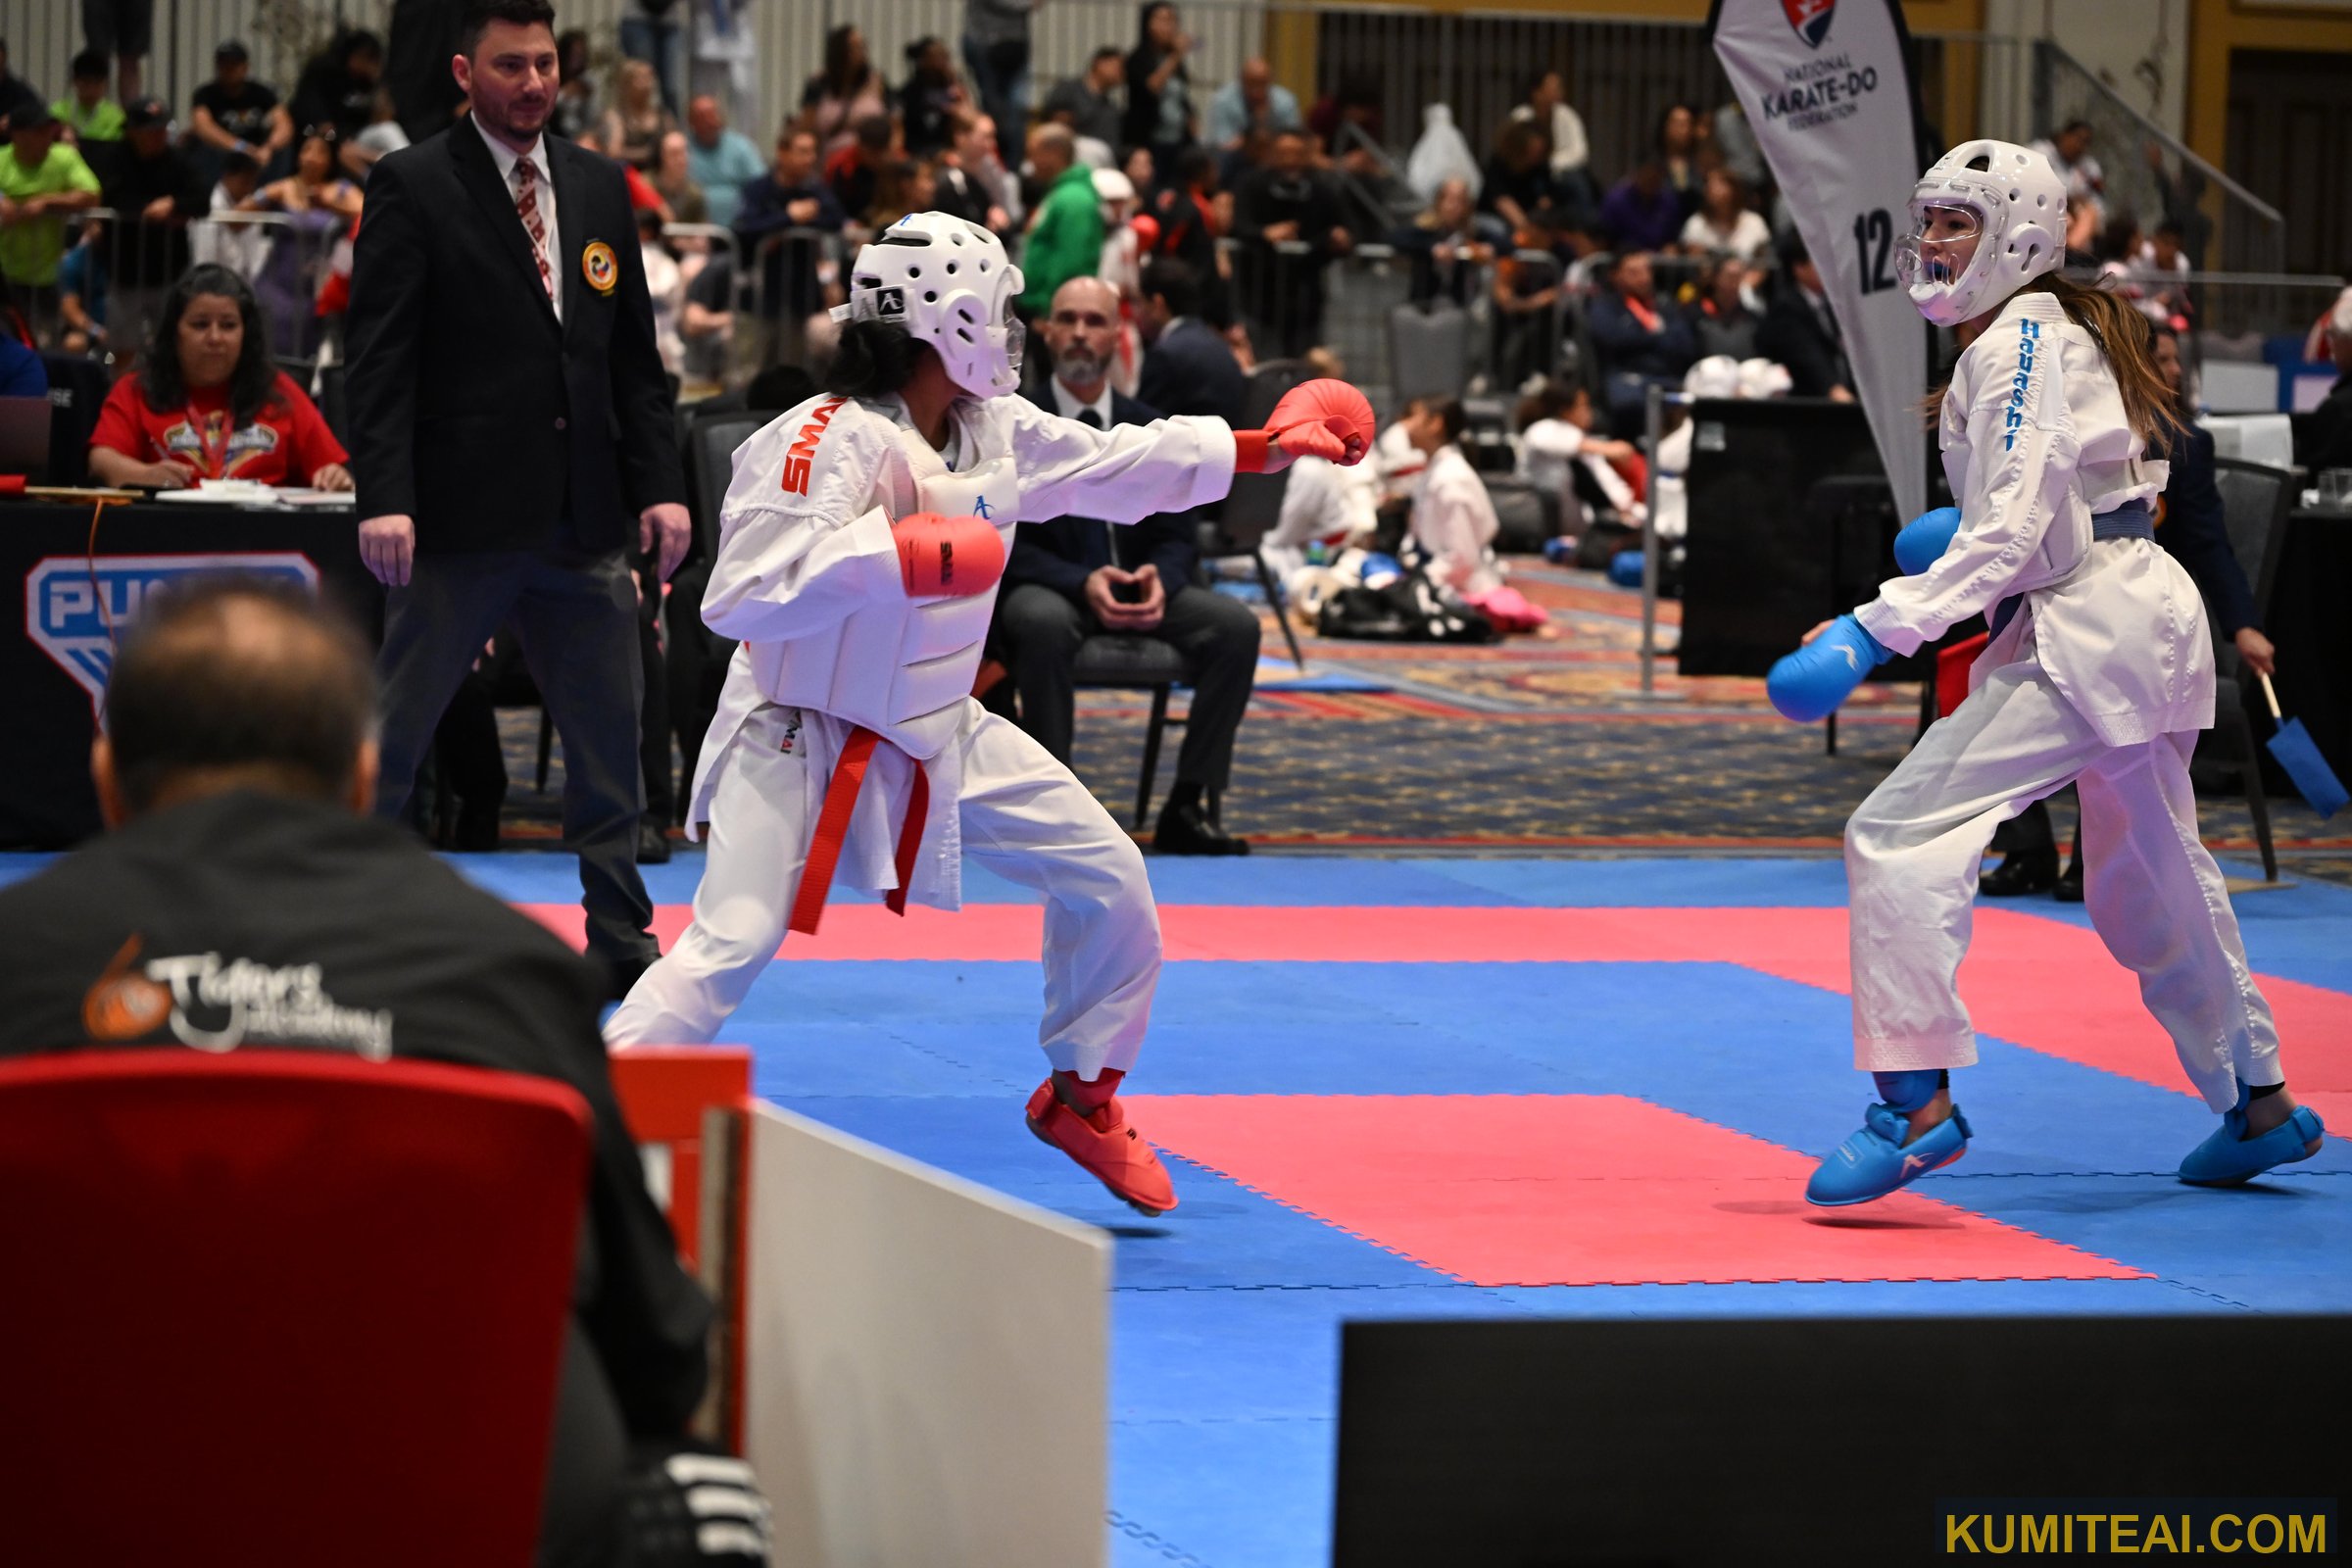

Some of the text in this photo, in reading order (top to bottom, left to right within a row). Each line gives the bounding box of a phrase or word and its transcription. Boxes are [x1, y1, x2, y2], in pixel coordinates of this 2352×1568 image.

[1762, 66, 1878, 120] KARATE-DO
[1853, 207, 1897, 295] 12
[2003, 318, 2040, 452] Hayashi
